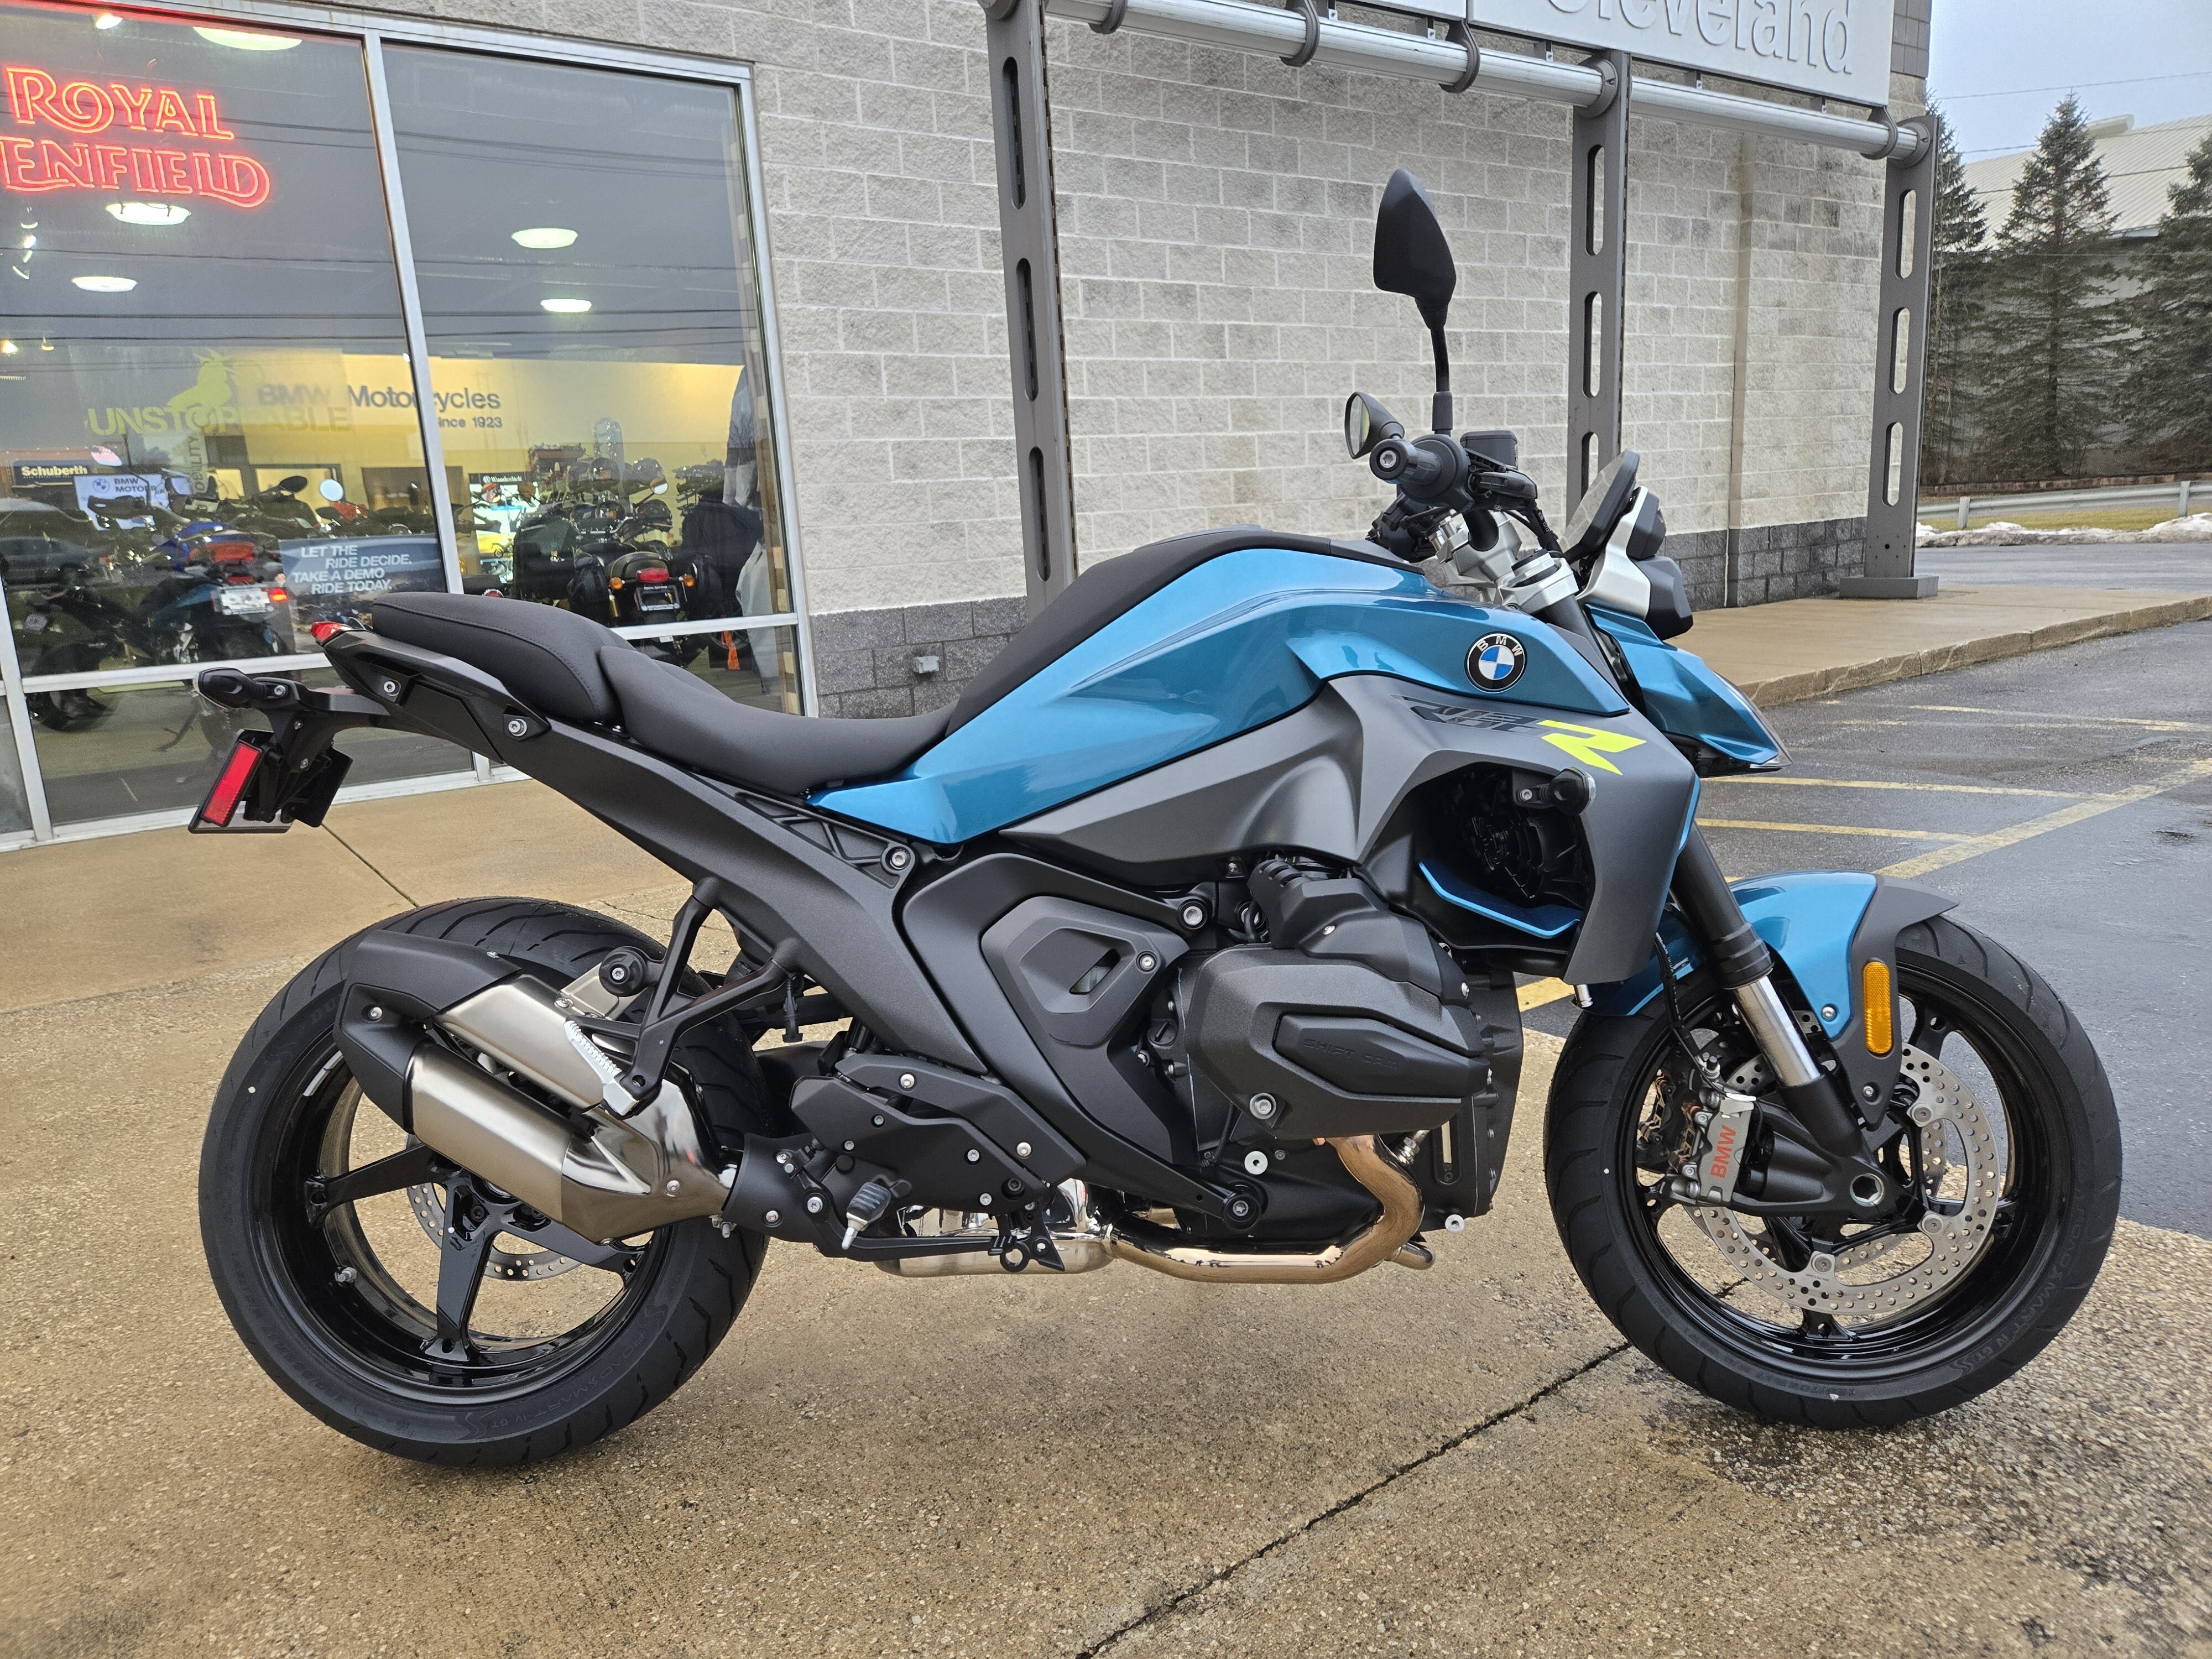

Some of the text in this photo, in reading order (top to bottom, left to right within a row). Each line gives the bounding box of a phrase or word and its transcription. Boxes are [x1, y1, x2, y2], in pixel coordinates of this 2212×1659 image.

[1548, 0, 1851, 75] eveland
[4, 66, 236, 141] ROYAL
[0, 135, 270, 208] ENFIELD
[257, 383, 502, 413] BMW Motoycles
[88, 406, 351, 436] UNSTOPBLE
[437, 416, 503, 429] ince 1923
[21, 465, 88, 476] Schuberth
[301, 545, 358, 558] LET THE
[325, 554, 413, 569] RIDE DECIDE.
[292, 567, 385, 583] TAKE A DEMO
[311, 578, 393, 595] RIDE TODAY.
[1477, 635, 1524, 657] BMW
[1303, 1037, 1399, 1070] SHIFT CAM
[1710, 1124, 1737, 1178] BMW
[488, 1333, 645, 1430] ROADSMART IV GT
